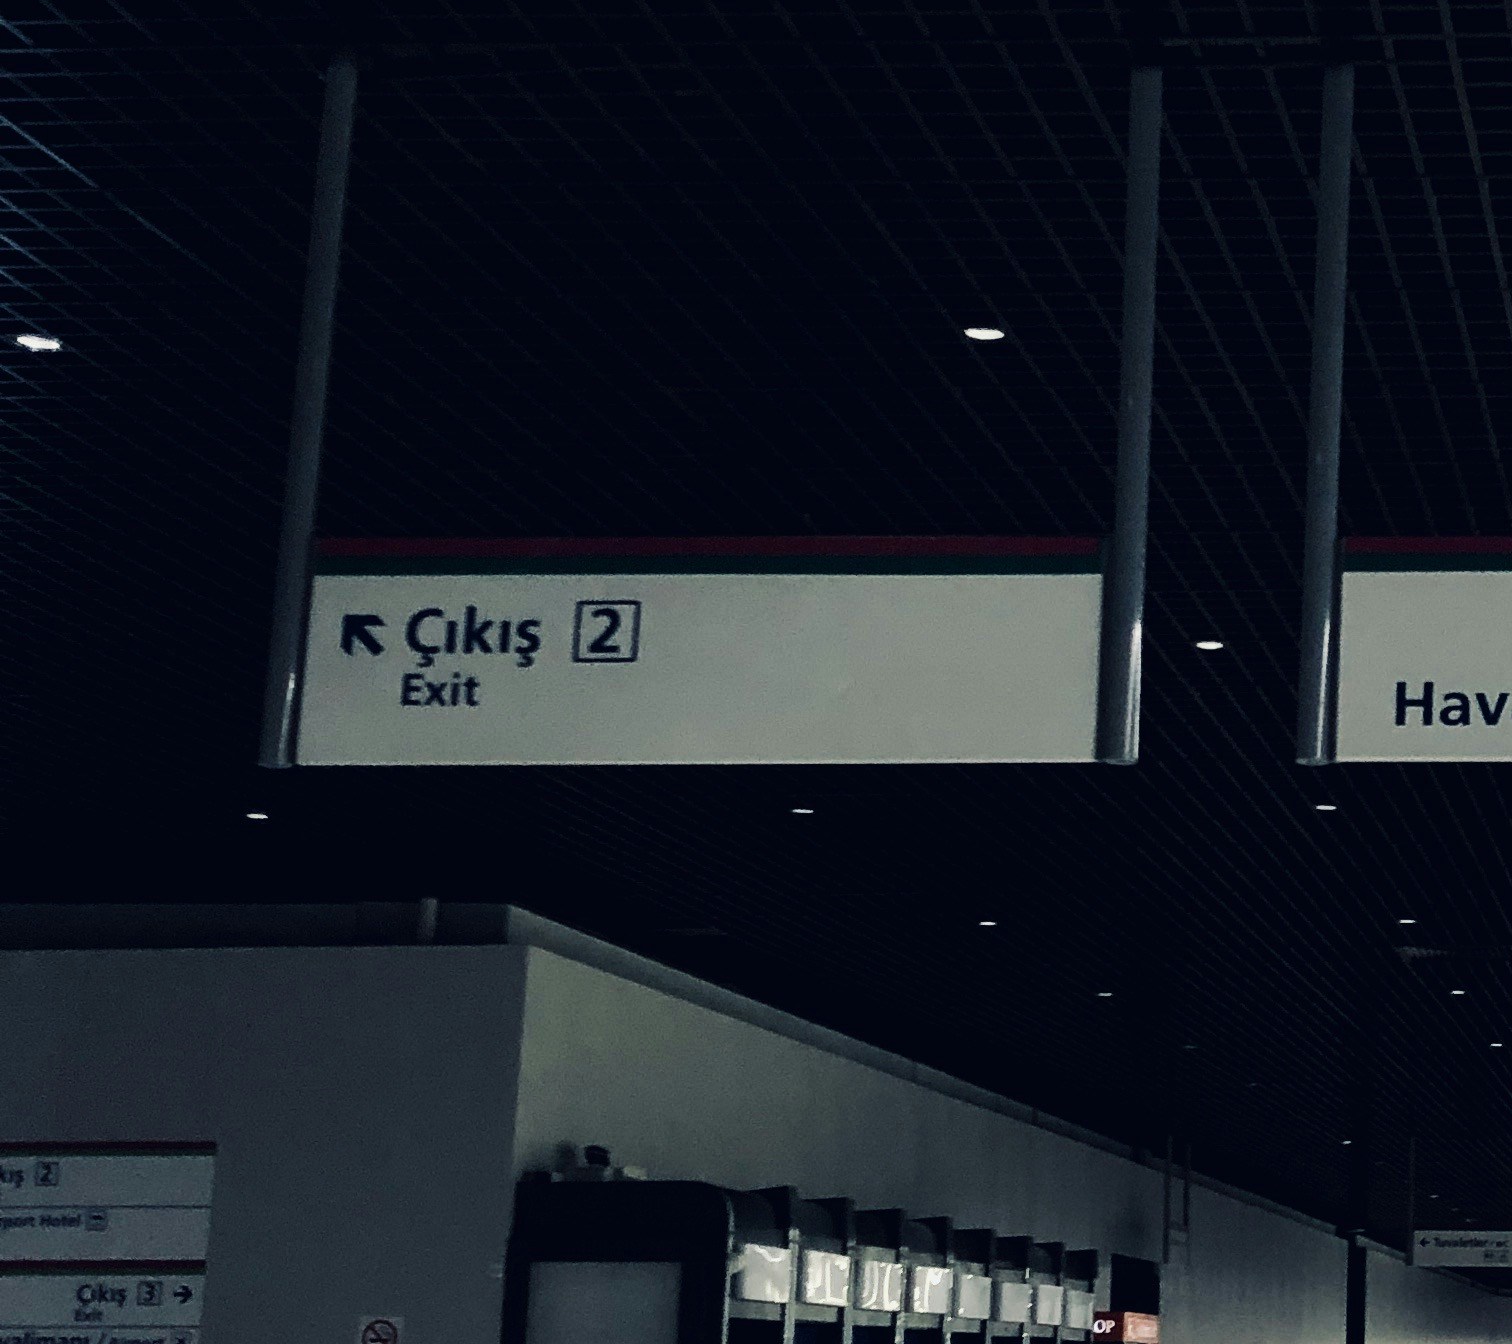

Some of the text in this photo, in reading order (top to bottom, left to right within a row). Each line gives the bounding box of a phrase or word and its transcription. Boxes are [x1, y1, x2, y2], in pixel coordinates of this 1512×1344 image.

[403, 604, 623, 670] Çıkış 2
[398, 671, 482, 709] Exit
[76, 1283, 127, 1307] Çıkış
